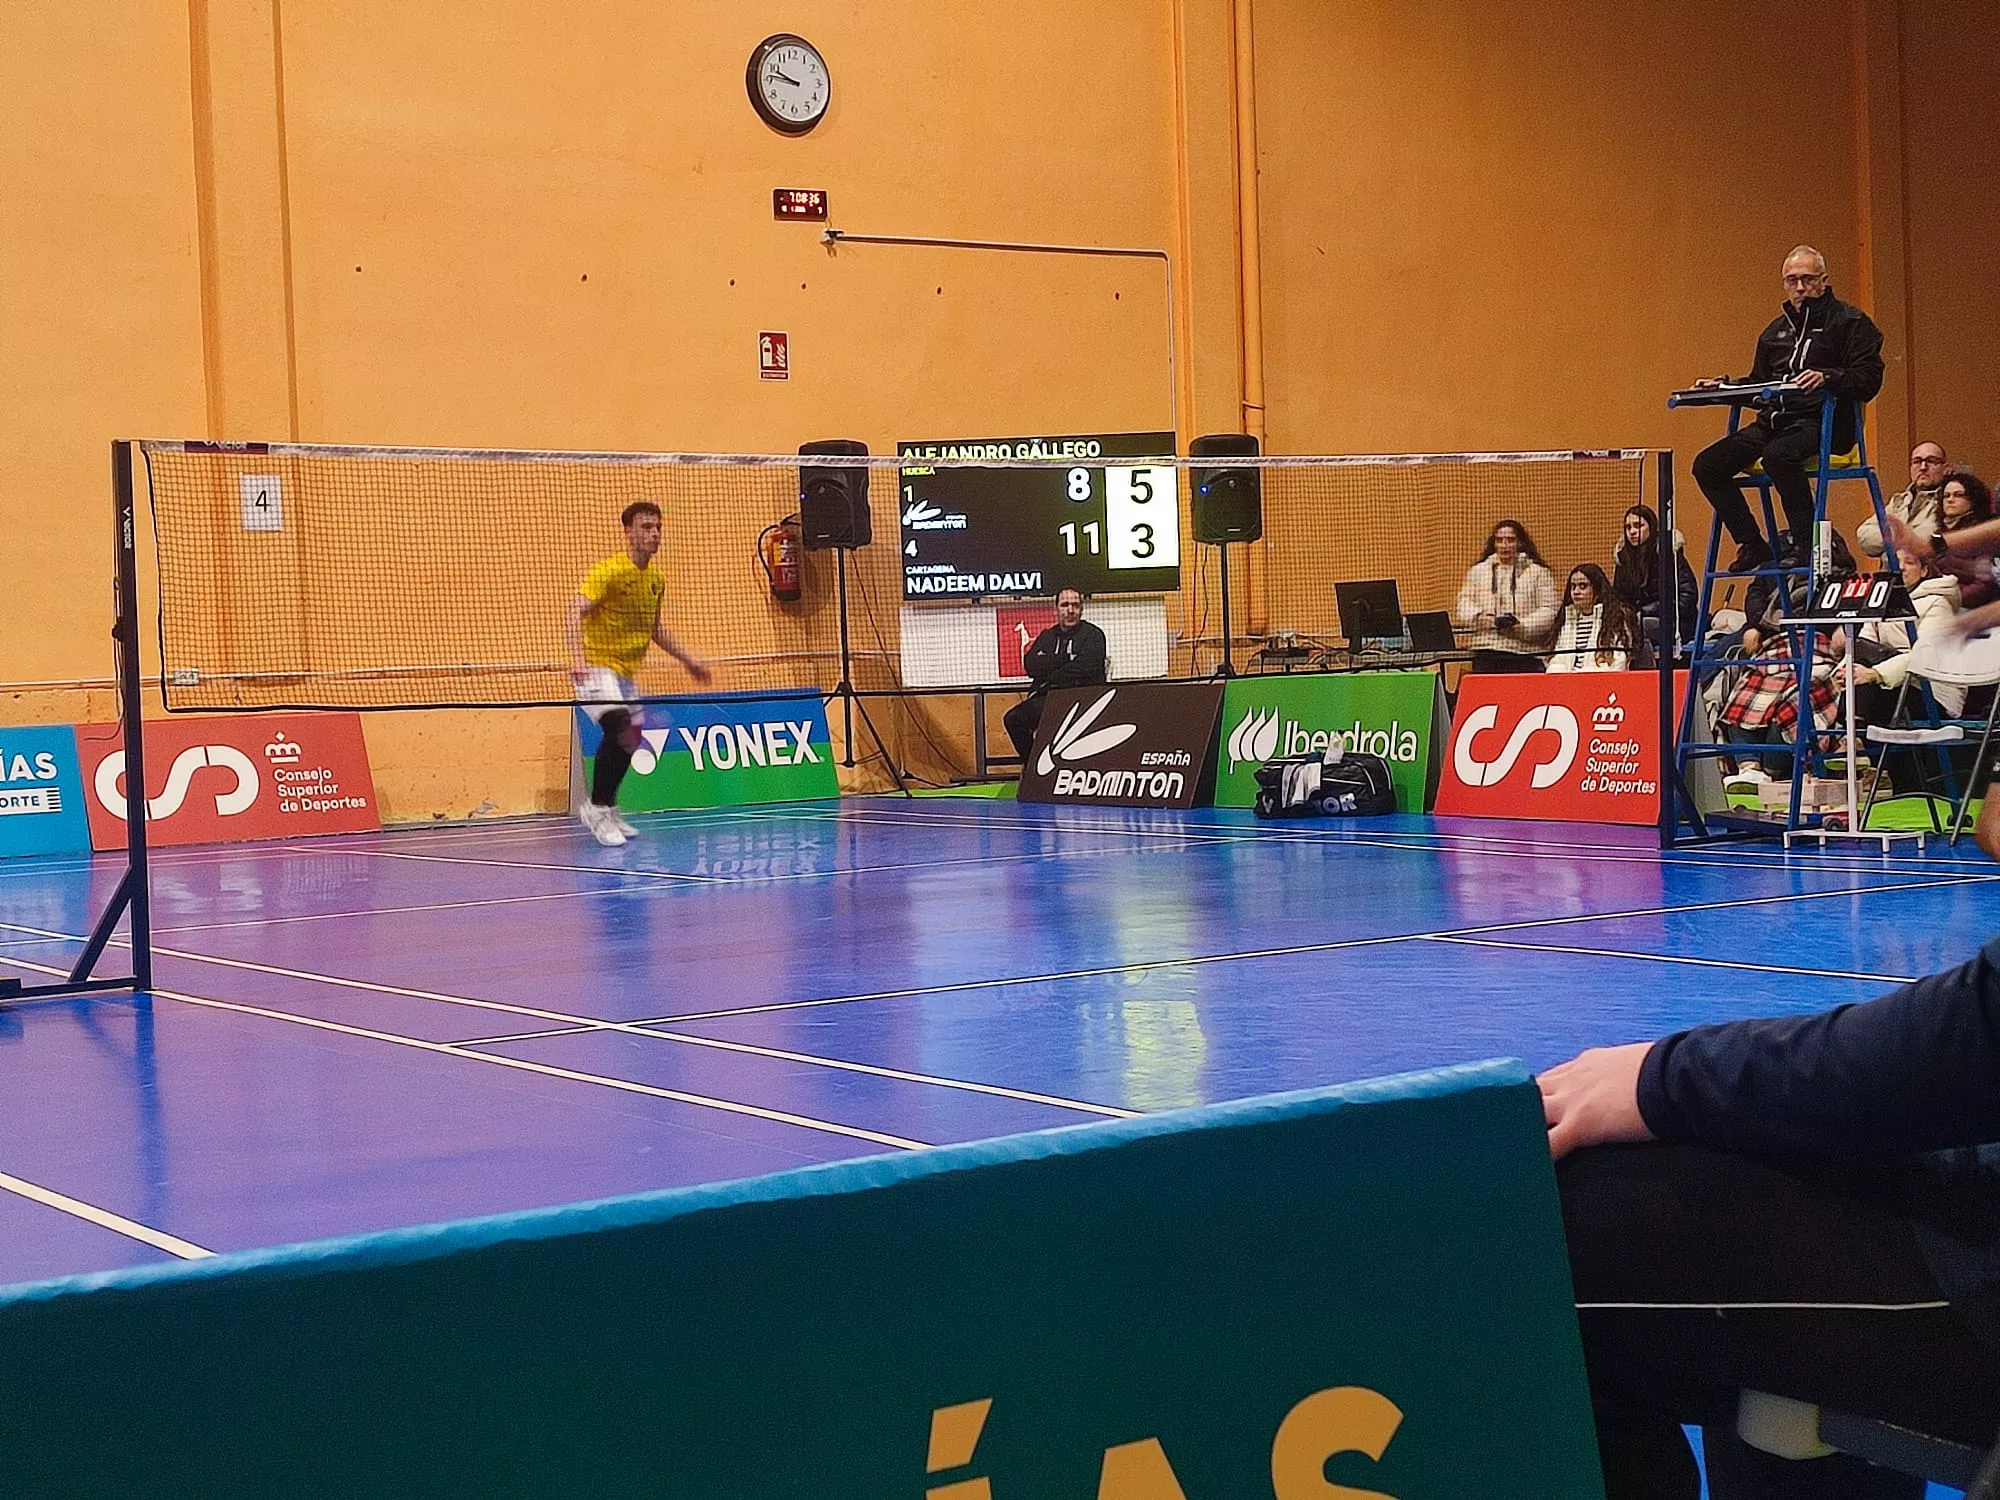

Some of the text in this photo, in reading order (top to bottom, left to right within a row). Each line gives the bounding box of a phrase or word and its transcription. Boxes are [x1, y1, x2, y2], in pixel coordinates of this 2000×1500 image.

[778, 53, 786, 63] 11
[788, 49, 798, 60] 12
[769, 63, 780, 73] 10
[809, 63, 817, 73] 2
[769, 89, 777, 99] 8
[811, 91, 817, 101] 4
[780, 99, 786, 109] 7
[791, 103, 798, 114] 6
[804, 101, 810, 112] 5
[1067, 467, 1091, 502] 8
[1130, 469, 1153, 504] 5
[255, 490, 272, 512] 4
[903, 485, 914, 503] 1
[1058, 521, 1101, 556] 11
[1130, 523, 1155, 559] 3
[904, 539, 918, 557] 4
[907, 572, 1042, 594] NADEEM DALVI
[1820, 582, 1842, 609] 0
[1867, 580, 1889, 608] 0
[678, 720, 820, 771] YONEX
[1589, 738, 1640, 758] Consejo
[1140, 750, 1191, 766] ESPAÑA
[1585, 757, 1640, 776] Superior
[274, 766, 332, 782] Consejo
[277, 783, 339, 799] Superior
[1053, 769, 1184, 799] BADMINTON
[1581, 776, 1657, 796] de Deportes
[280, 796, 367, 813] de Deportes
